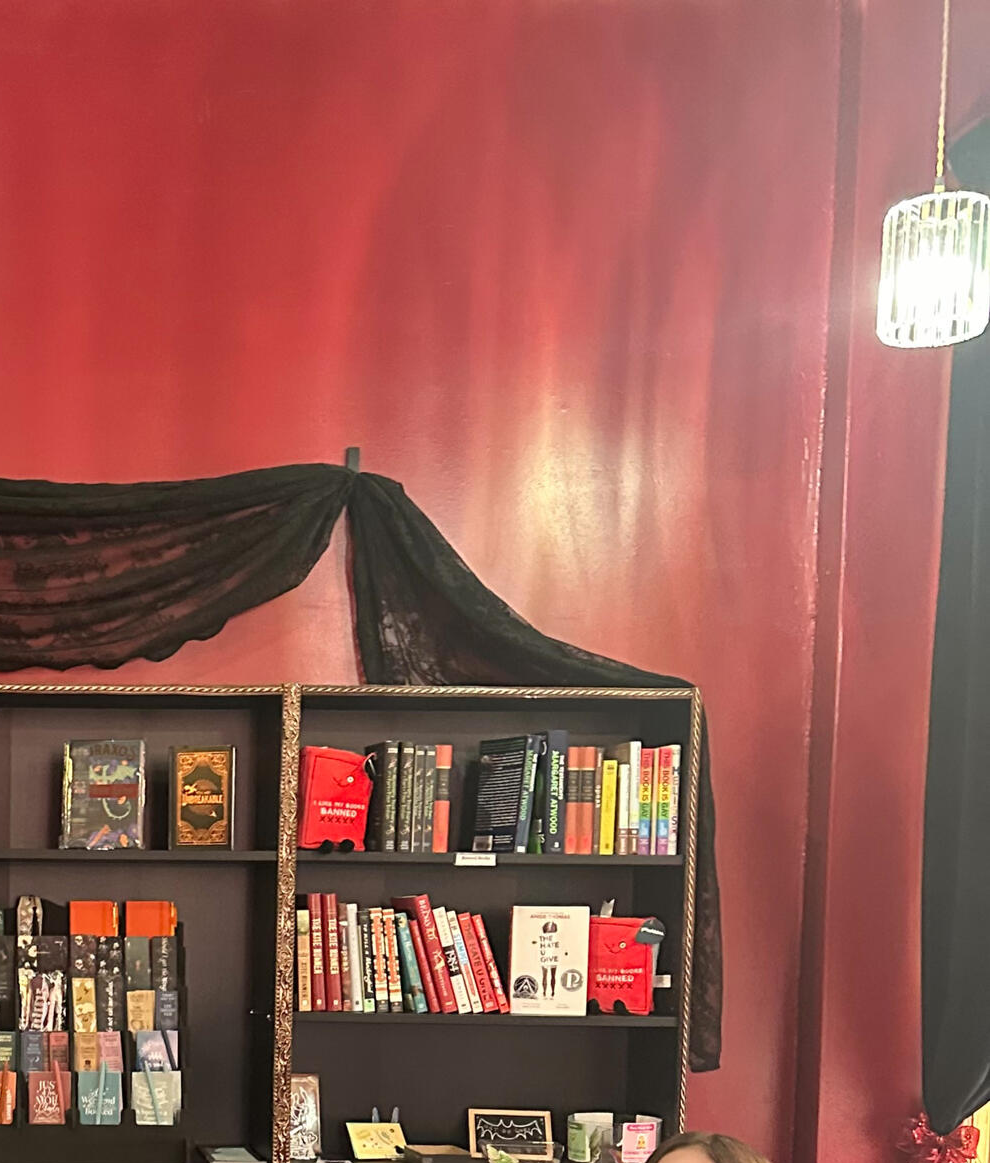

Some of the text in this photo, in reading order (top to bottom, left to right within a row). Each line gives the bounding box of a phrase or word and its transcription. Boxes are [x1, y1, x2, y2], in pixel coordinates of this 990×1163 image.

[642, 752, 651, 768] THIS
[661, 752, 670, 768] THIS
[550, 750, 560, 834] MARGARET ATWOOD
[642, 770, 651, 792] BOOK
[661, 770, 670, 792] BOOK
[320, 807, 357, 818] BANNED
[642, 803, 650, 818] GAY
[661, 803, 670, 818] GAY
[312, 918, 323, 974] THE KITE RUNNER
[328, 918, 339, 974] THE KITE RUNNER
[471, 944, 482, 967] HATE
[341, 946, 349, 972] speak
[363, 957, 373, 993] Mockingbird
